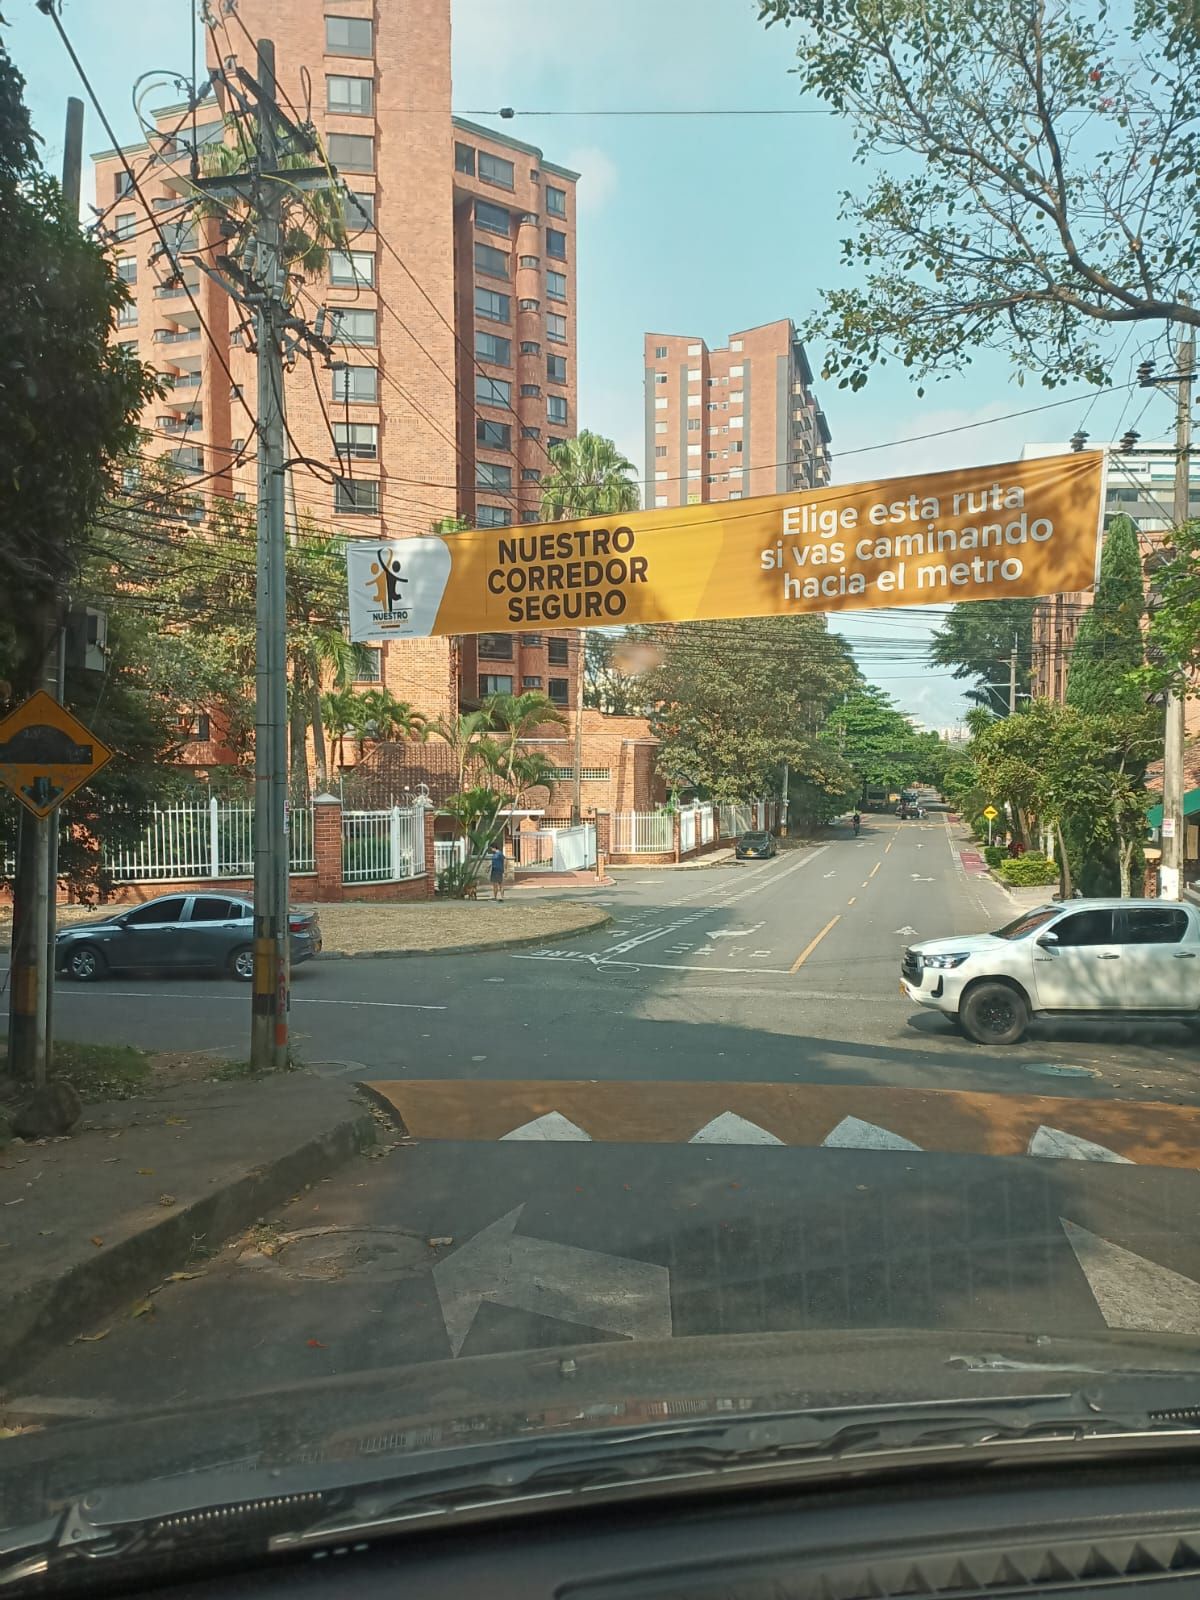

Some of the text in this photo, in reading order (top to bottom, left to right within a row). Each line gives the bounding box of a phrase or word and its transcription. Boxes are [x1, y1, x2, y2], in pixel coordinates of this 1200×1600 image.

[782, 483, 1025, 539] Elige esta ruta
[498, 526, 635, 565] NUESTRO
[760, 512, 1054, 570] si vas caminando
[488, 556, 649, 595] CORREDOR
[783, 555, 1023, 600] hacia el metro
[372, 610, 408, 621] NUESTRO
[508, 589, 627, 623] SEGURO
